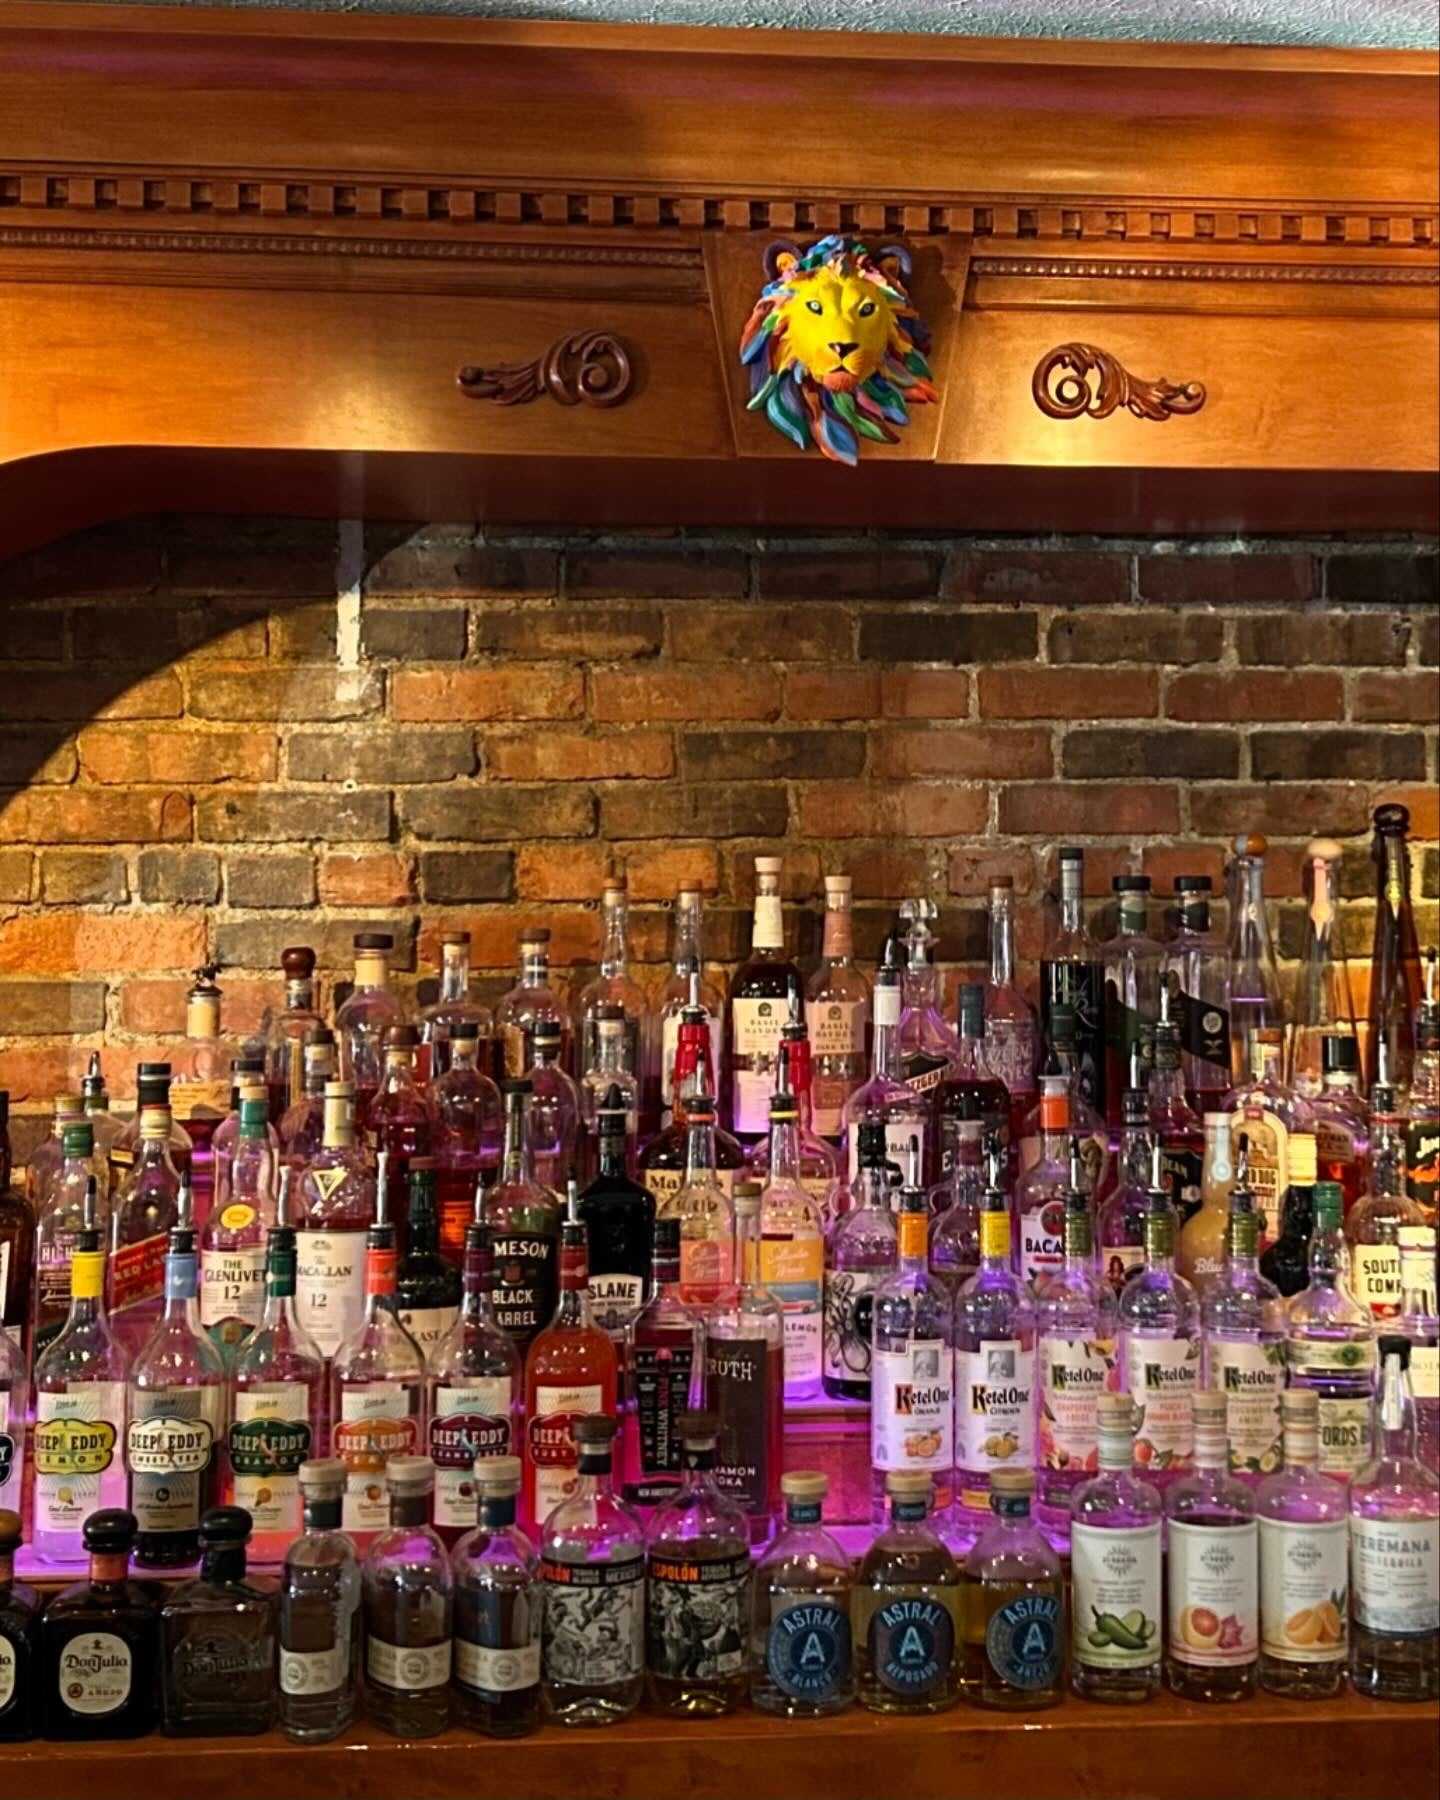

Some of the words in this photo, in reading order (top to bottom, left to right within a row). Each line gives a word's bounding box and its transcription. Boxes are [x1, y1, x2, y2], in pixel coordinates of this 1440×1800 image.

[1024, 1237, 1066, 1254] BACA
[223, 1259, 242, 1270] THE
[205, 1269, 266, 1282] GLENLIVET
[223, 1285, 241, 1300] 12
[310, 1293, 328, 1308] 12
[491, 1289, 534, 1304] BLACK
[588, 1282, 638, 1300] SLANE
[497, 1310, 537, 1327] ARREL
[785, 1322, 818, 1334] LEMON
[704, 1357, 753, 1380] RUTH
[1052, 1364, 1083, 1390] Ketel
[1083, 1367, 1104, 1382] One
[1145, 1363, 1178, 1391] Ketel
[1179, 1364, 1197, 1380] One
[1223, 1365, 1257, 1393] Ketel
[1257, 1371, 1277, 1386] One
[896, 1383, 931, 1415] Ketel
[932, 1386, 950, 1403] One
[972, 1384, 1007, 1416] Ketel
[1008, 1387, 1029, 1404] One
[71, 1432, 106, 1450] EDDY
[131, 1433, 159, 1449] DEEP
[168, 1432, 205, 1450] EDDY
[232, 1434, 260, 1451] DEEP
[270, 1433, 305, 1451] EDDY
[338, 1434, 368, 1451] DEEP
[379, 1431, 412, 1450] EDDY
[432, 1428, 459, 1445] DEEP
[471, 1427, 506, 1446] EDDY
[533, 1428, 563, 1444] DEEP
[656, 1408, 669, 1467] WHITNEY
[716, 1465, 757, 1475] AMON
[881, 1600, 941, 1628] ASTRAL
[1004, 1597, 1058, 1625] ASTRAL
[781, 1607, 841, 1635] ASTRAL
[898, 1625, 926, 1658] A
[1022, 1621, 1046, 1653] A
[799, 1631, 827, 1664] A
